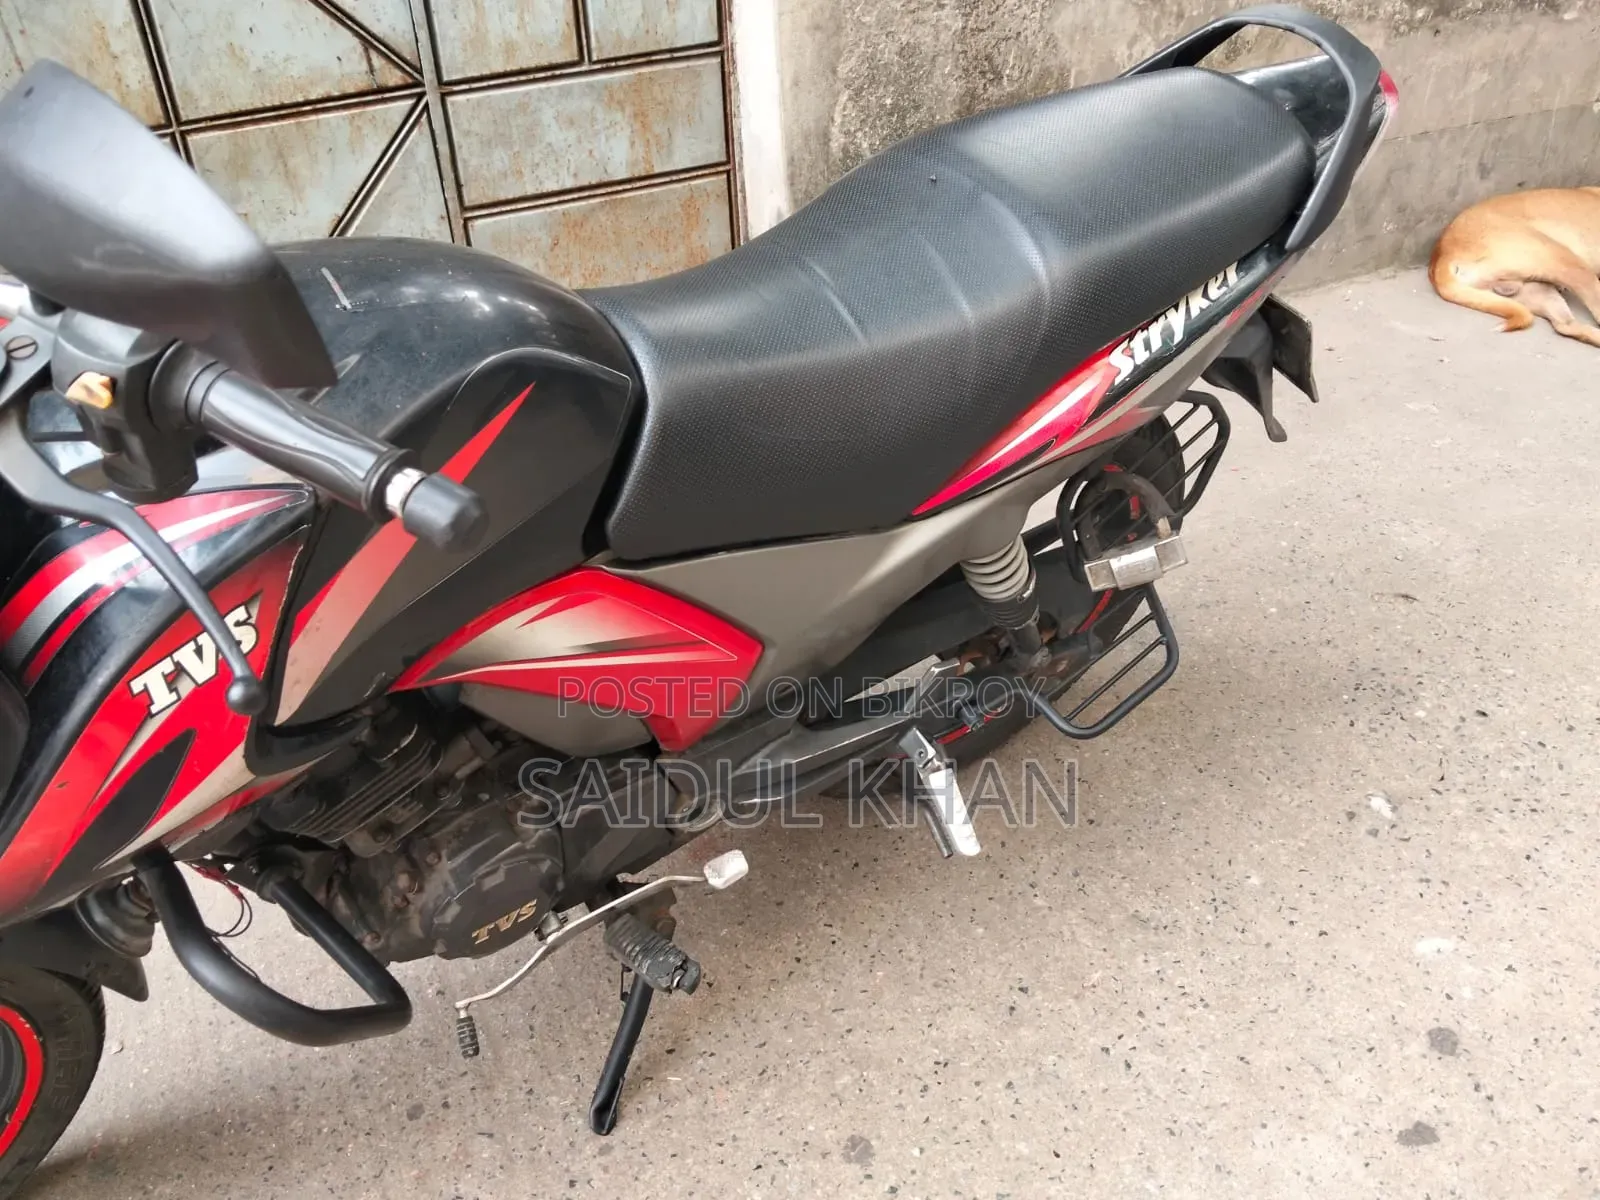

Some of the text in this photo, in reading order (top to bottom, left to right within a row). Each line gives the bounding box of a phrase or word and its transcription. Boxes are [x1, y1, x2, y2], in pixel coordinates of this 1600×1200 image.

[1109, 261, 1239, 385] Stryker
[129, 604, 258, 718] TVS
[471, 899, 537, 944] TVS
